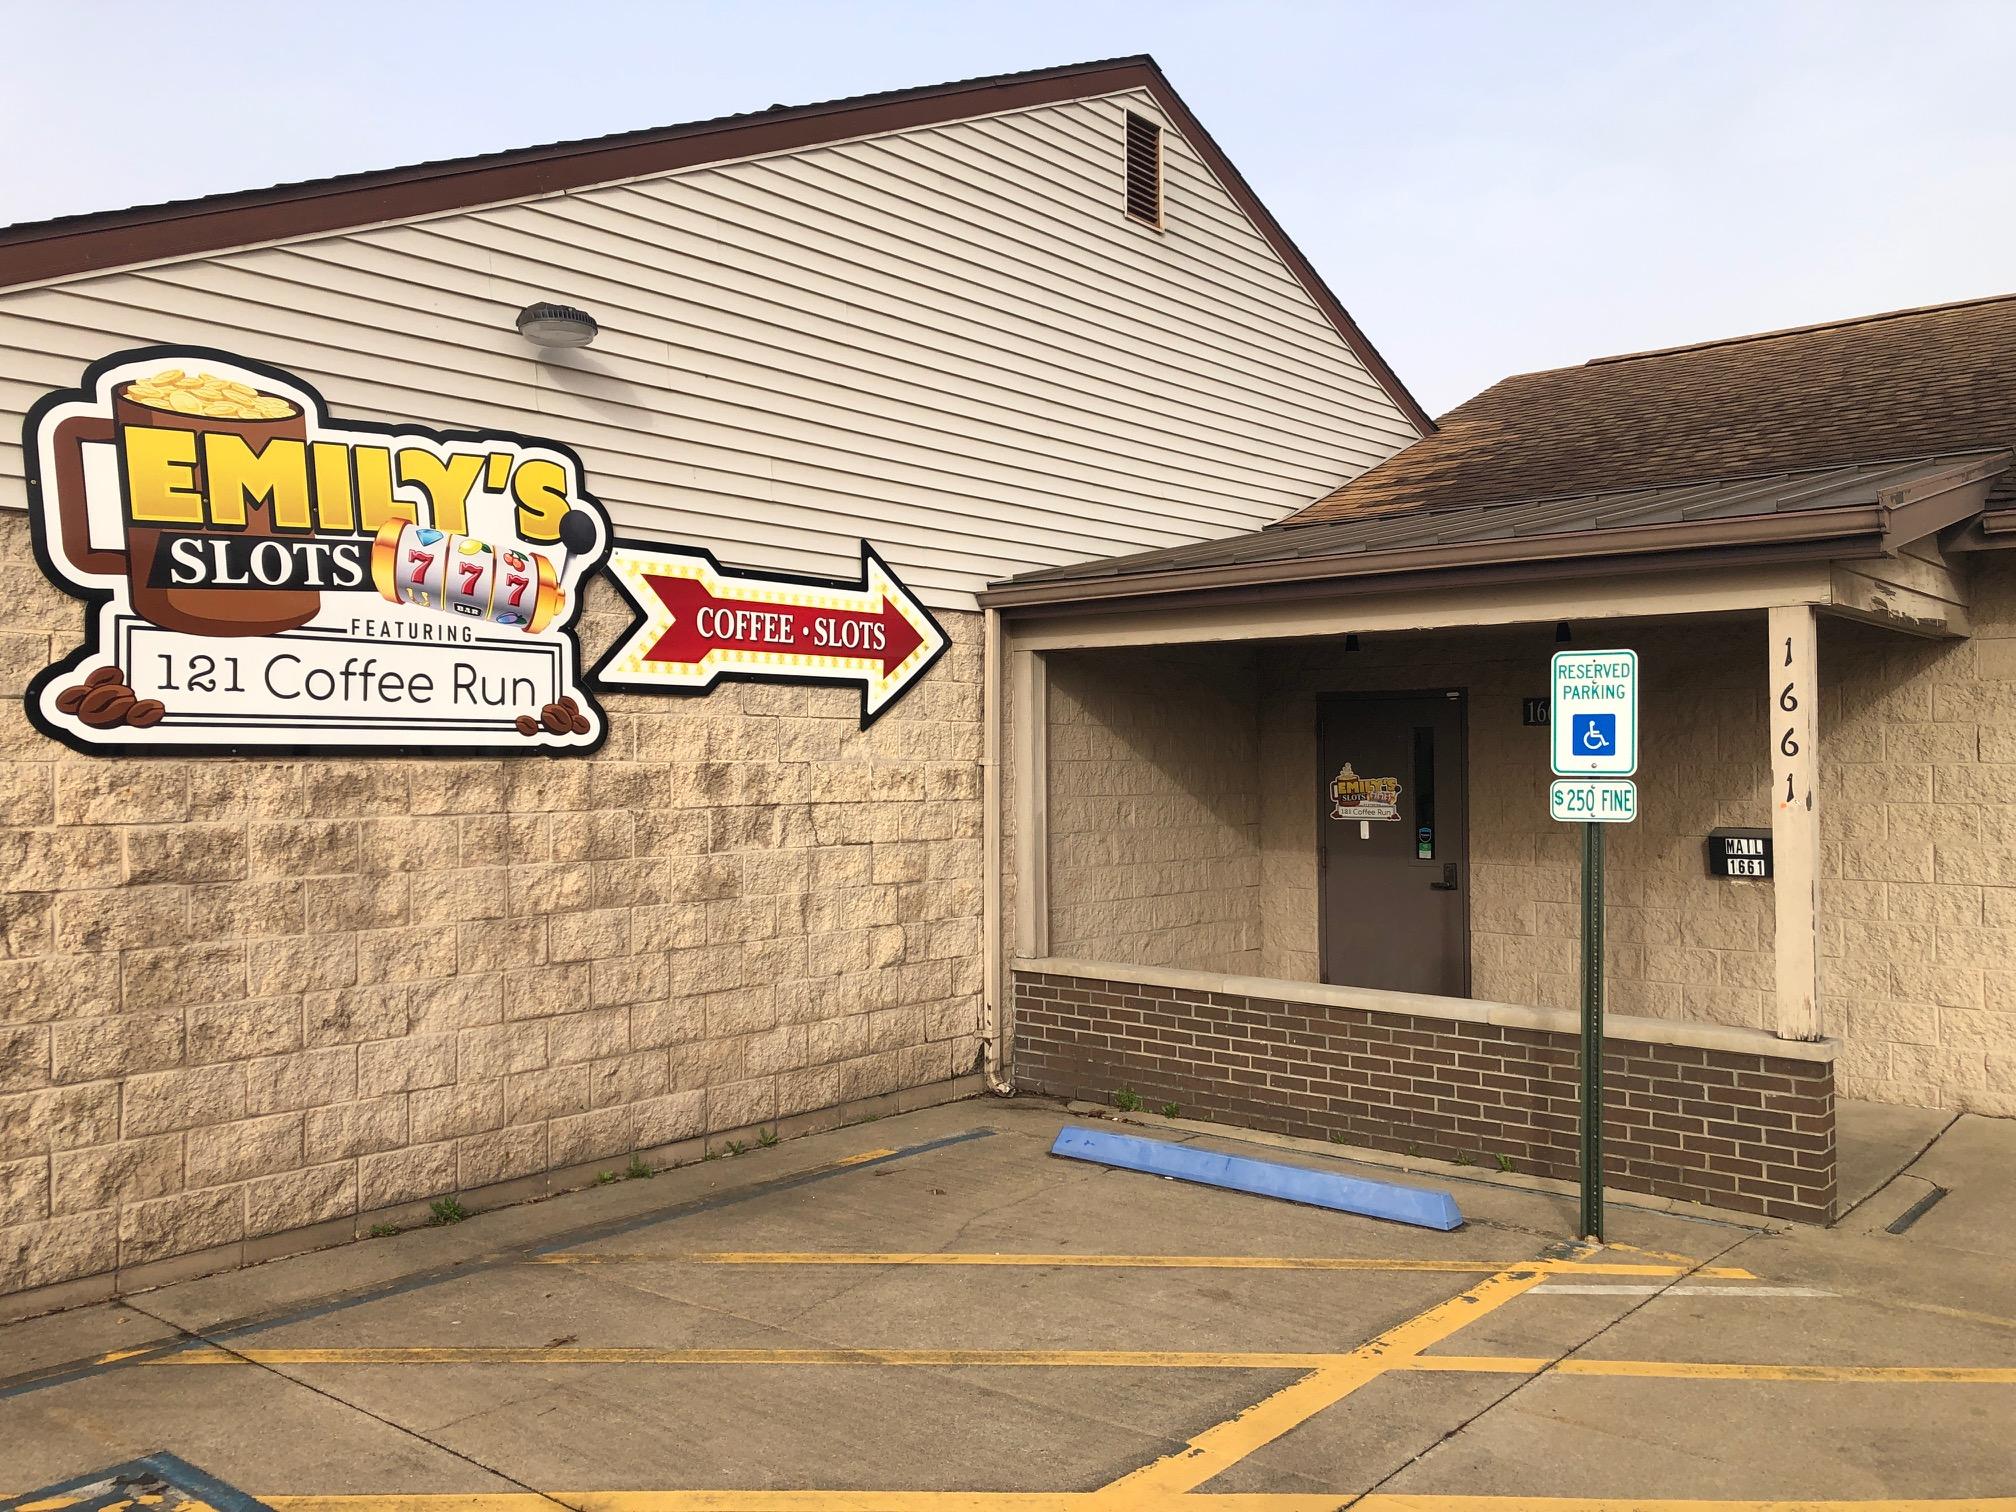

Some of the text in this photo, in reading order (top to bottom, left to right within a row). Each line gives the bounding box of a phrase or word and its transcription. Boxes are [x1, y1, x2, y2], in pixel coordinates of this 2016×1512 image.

[121, 424, 570, 542] EMILY'S
[169, 538, 362, 588] SLOTS
[409, 549, 529, 607] 7 7 7
[456, 605, 480, 616] BAR
[351, 618, 473, 642] FEATURING
[696, 606, 886, 650] COFFEE SLOTS
[157, 653, 536, 706] 121 Coffee Run
[1558, 663, 1630, 679] RESERVED
[1563, 685, 1625, 700] PARKING
[1779, 637, 1799, 802] 1661
[1602, 790, 1632, 811] FINE
[1353, 808, 1376, 816] Coffee
[1726, 839, 1762, 855] MAIL
[1730, 860, 1763, 875] 1661
